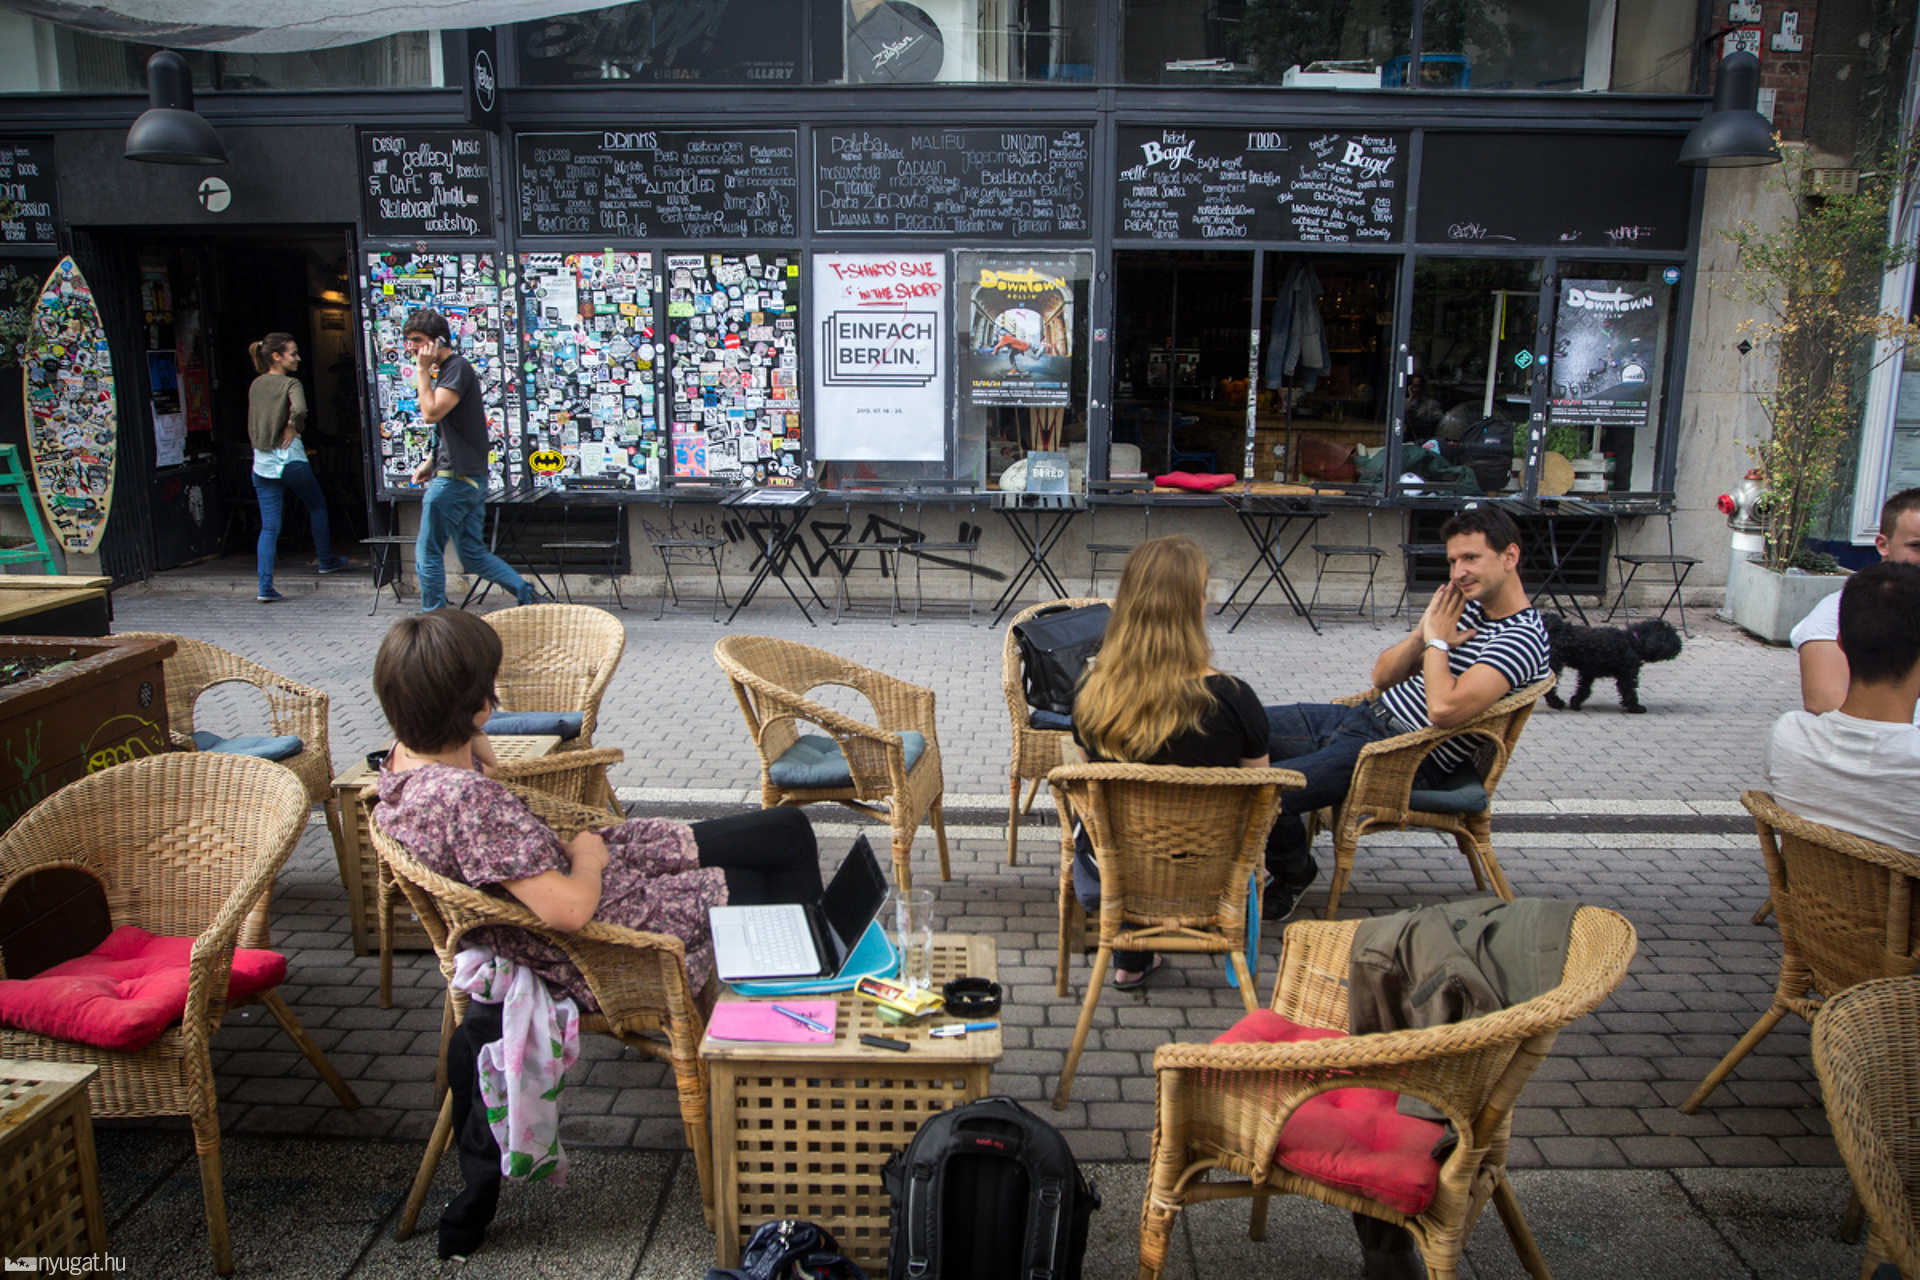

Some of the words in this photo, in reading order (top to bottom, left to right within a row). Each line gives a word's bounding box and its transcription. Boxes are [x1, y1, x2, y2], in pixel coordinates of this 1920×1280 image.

[1139, 139, 1197, 170] Bagel
[1340, 140, 1396, 179] Bagel
[839, 322, 932, 340] EINFACH
[839, 348, 921, 365] BERLIN.
